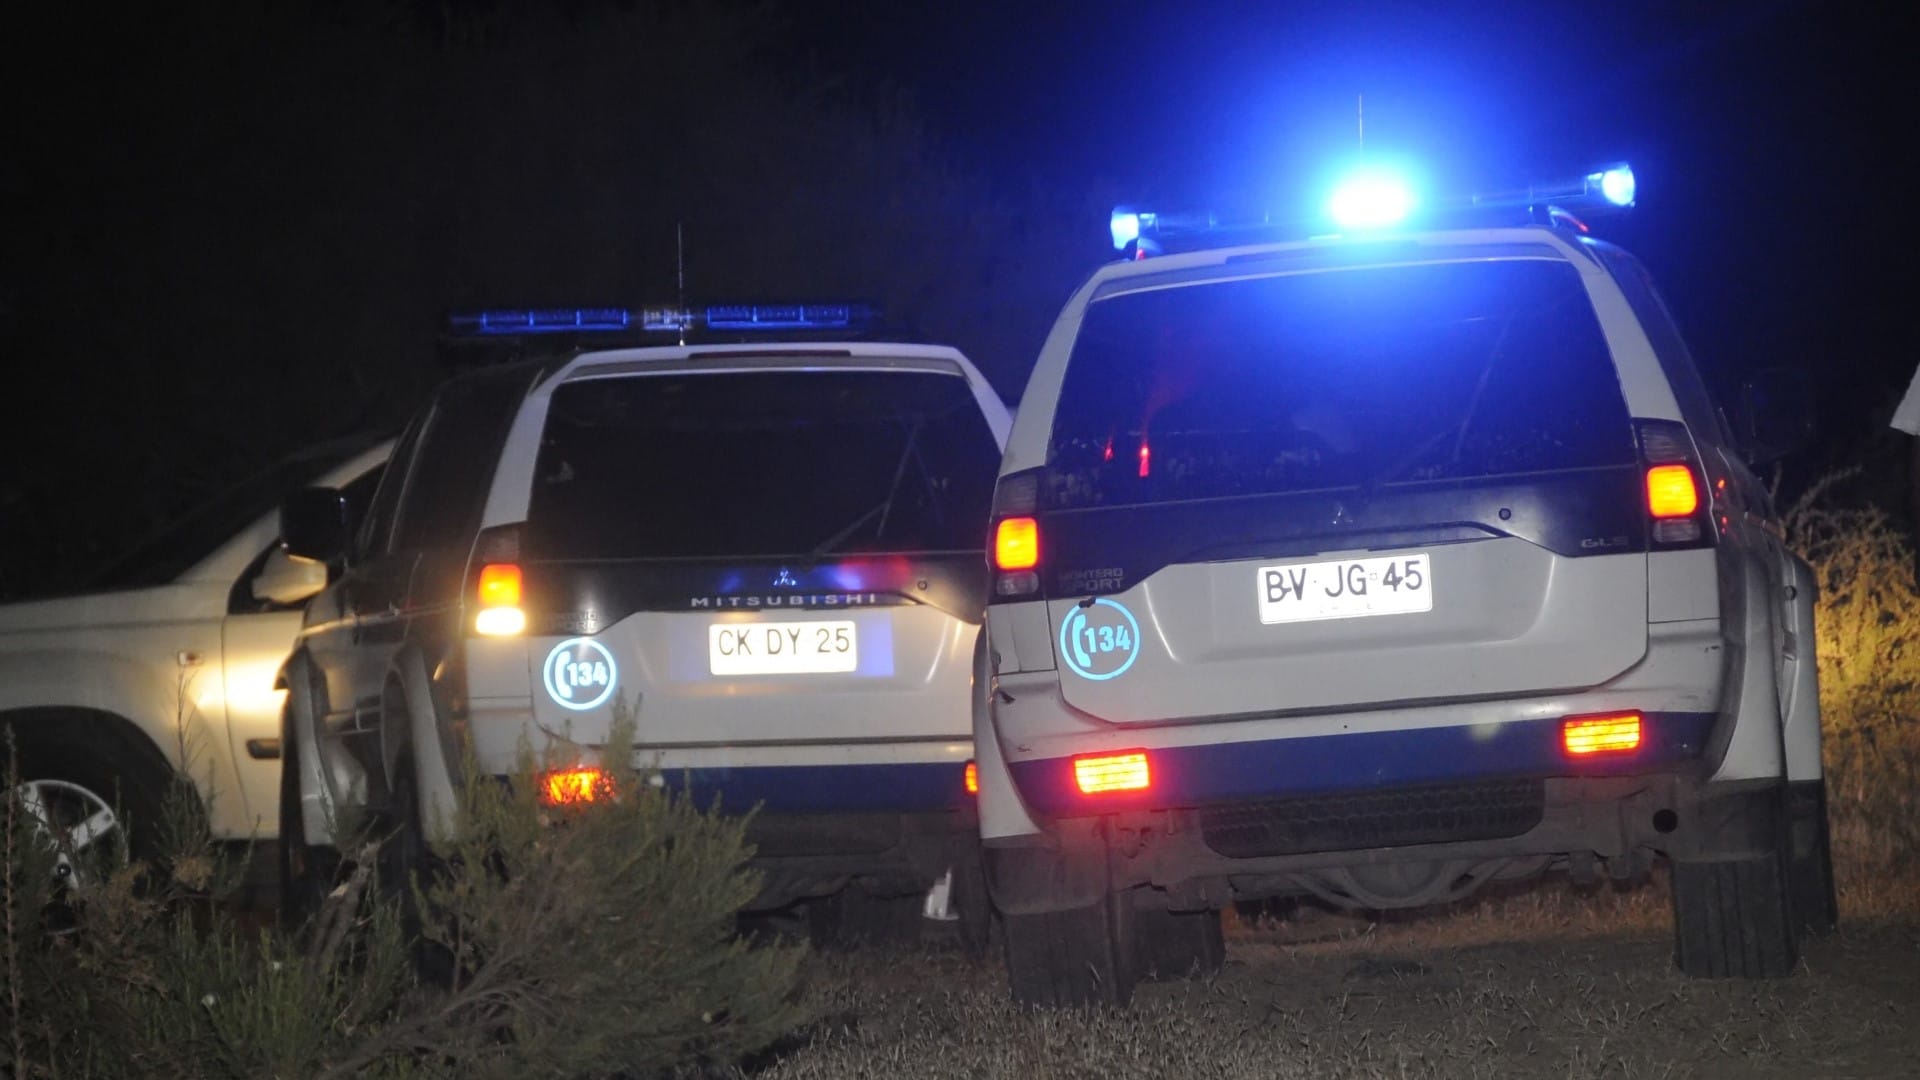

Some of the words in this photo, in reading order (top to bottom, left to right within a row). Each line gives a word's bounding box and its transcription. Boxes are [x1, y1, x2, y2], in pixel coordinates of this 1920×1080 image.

[1265, 568, 1307, 603] BV
[1324, 564, 1367, 598] JG
[1382, 560, 1422, 592] 45
[691, 593, 876, 607] MITSUBISHI
[718, 629, 752, 656] CK
[766, 628, 801, 655] DY
[816, 628, 850, 653] 25
[1084, 624, 1131, 653] 134
[566, 661, 608, 687] 134
